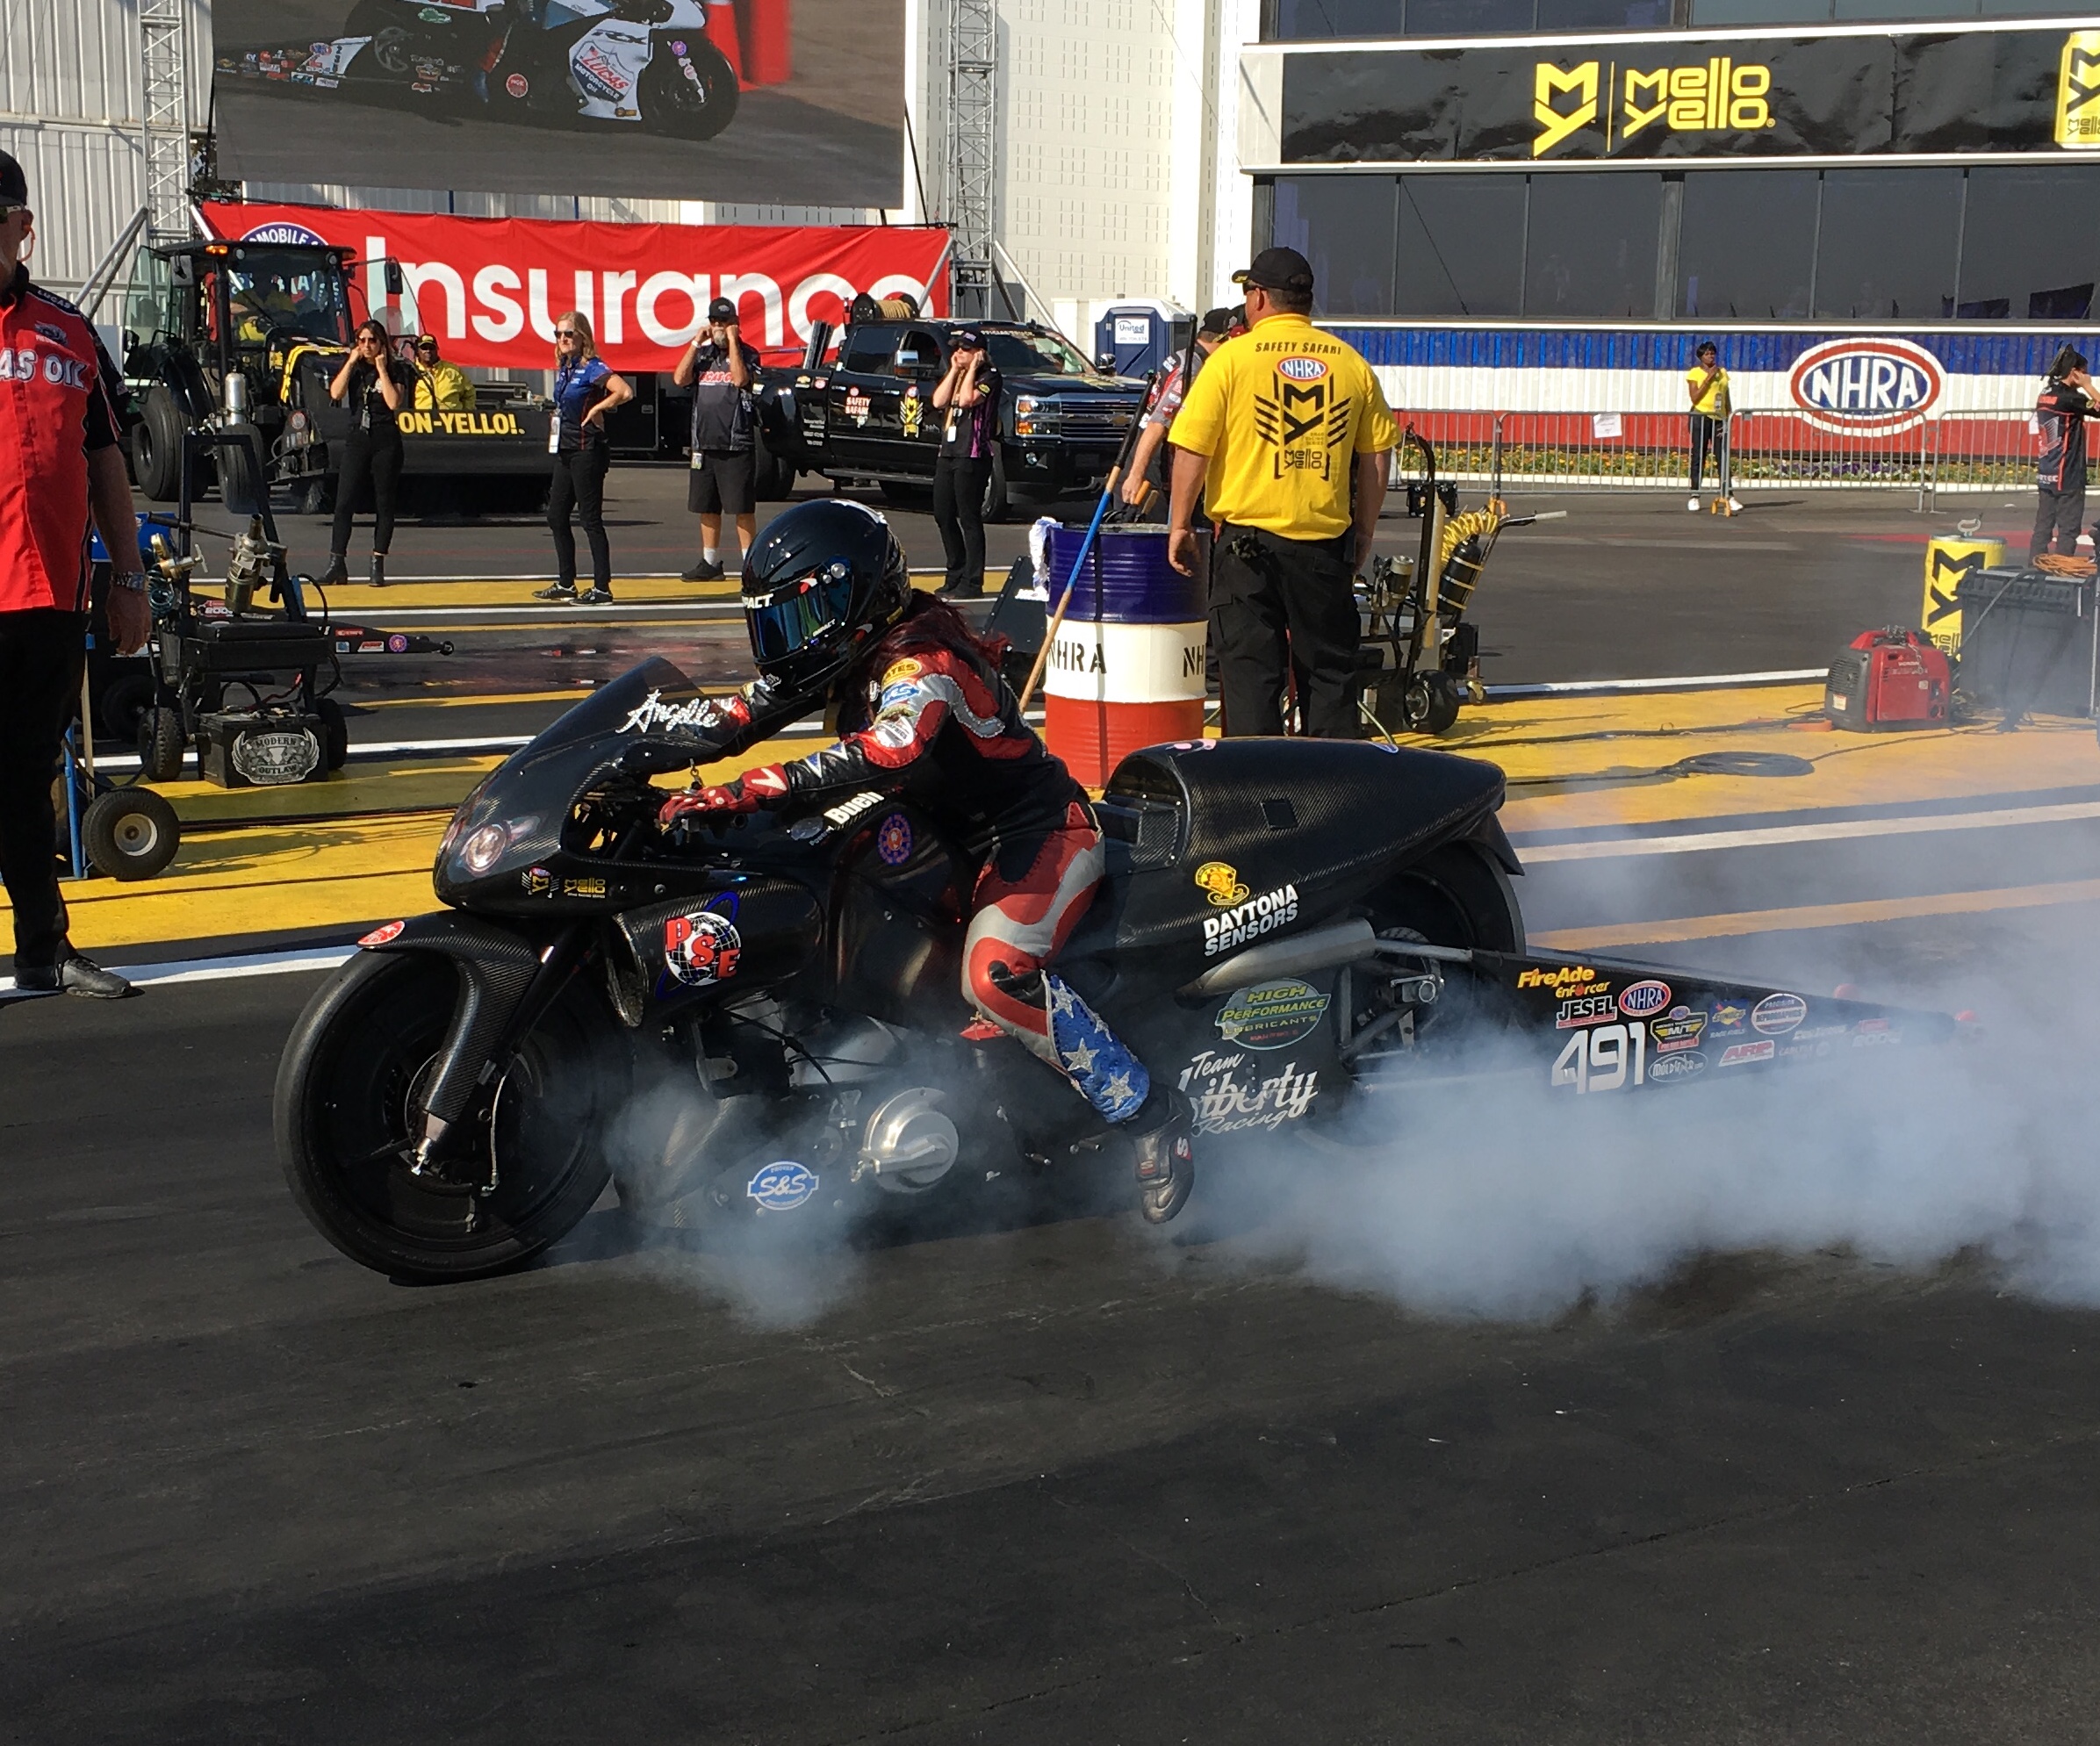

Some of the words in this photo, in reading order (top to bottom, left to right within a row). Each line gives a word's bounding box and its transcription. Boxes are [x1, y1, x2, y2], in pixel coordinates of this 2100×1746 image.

[574, 63, 620, 100] MOTORCYCLE
[582, 54, 629, 90] LUCAS
[1625, 58, 1769, 101] Mello
[2067, 126, 2100, 135] Yell
[2068, 116, 2100, 126] Mell
[1255, 341, 1298, 353] SAFETY
[1302, 342, 1341, 355] SAFARI
[1283, 360, 1321, 378] NHRA
[1811, 356, 1919, 409] NHRA
[845, 406, 869, 415] SAFARI
[846, 397, 871, 406] SAFETY
[812, 619, 835, 637] IMPACT
[255, 737, 297, 748] MODERN
[258, 765, 297, 774] OUTLAW
[1203, 884, 1298, 939] DAYTONA
[1205, 902, 1298, 957] SENSORS
[1518, 966, 1596, 988] FireAde
[1247, 984, 1307, 1003] HIGH
[1628, 988, 1664, 1010] NHRA
[1221, 998, 1326, 1022] PERFORMANCE
[1558, 996, 1616, 1021] JESEL
[1225, 1016, 1317, 1034] LUBRICANTS
[1191, 1051, 1245, 1078] Team
[1551, 1022, 1646, 1094] 491
[1191, 1108, 1286, 1137] Racing
[758, 1174, 808, 1196] S&S
